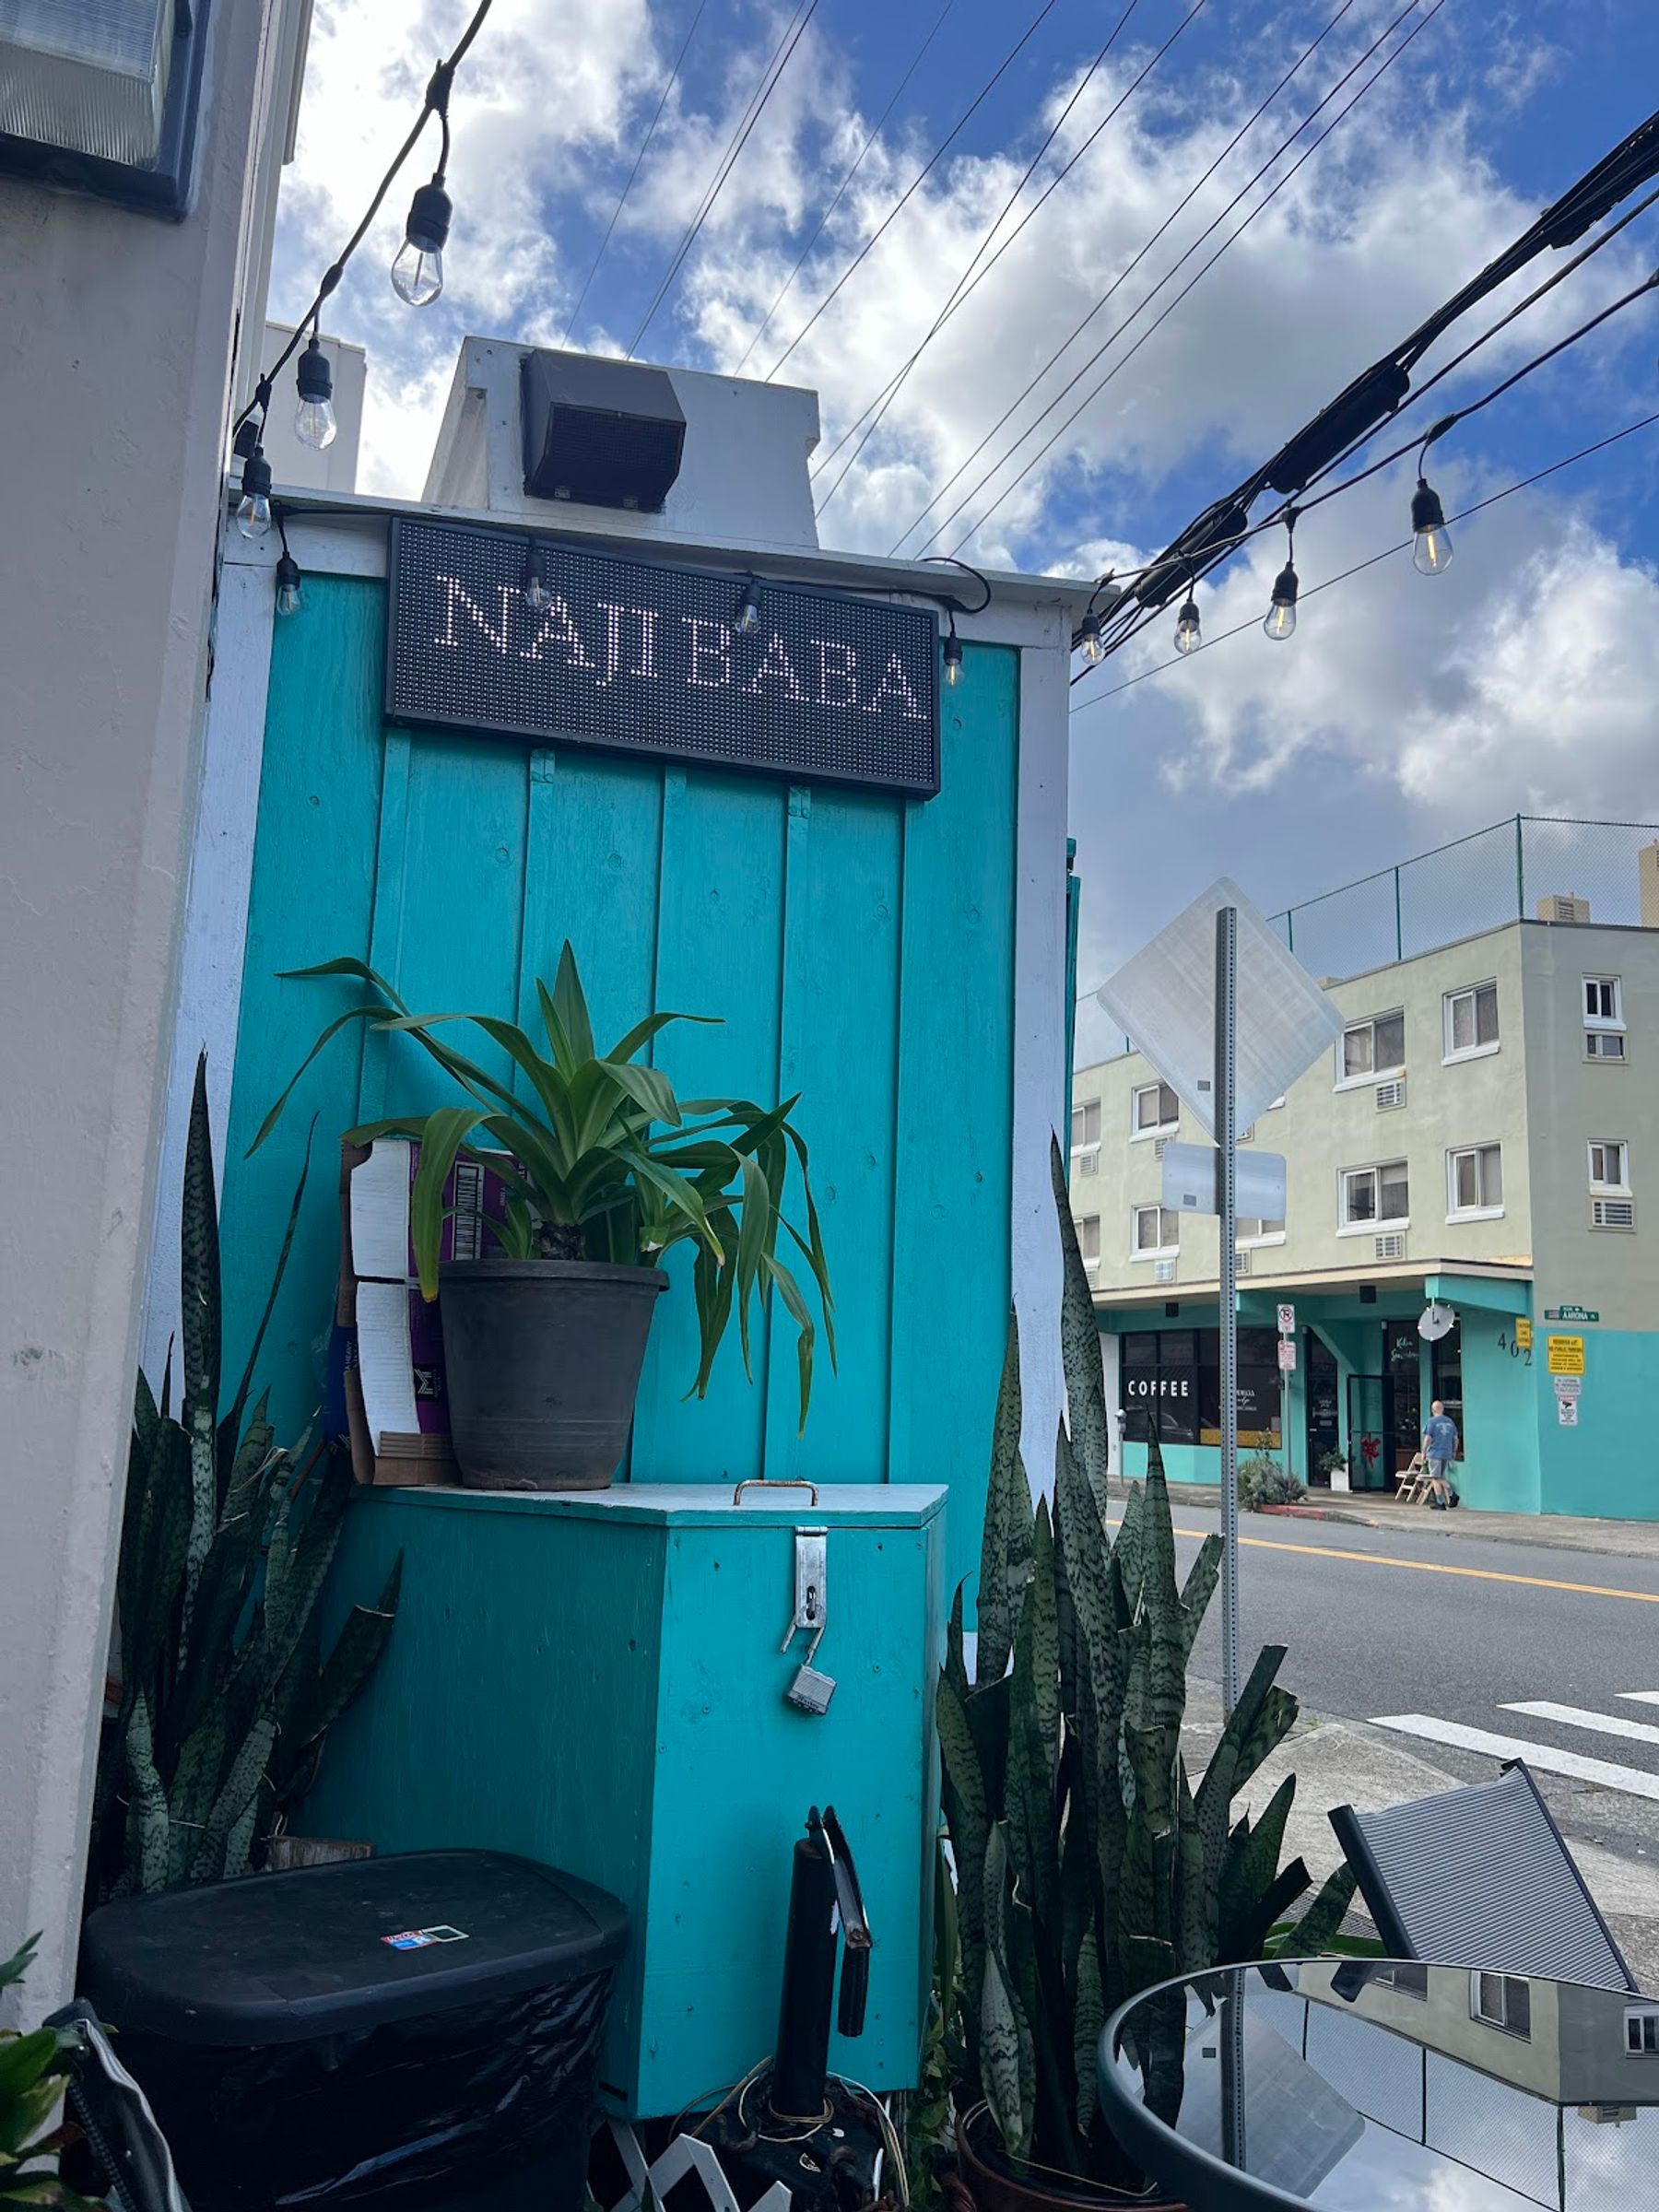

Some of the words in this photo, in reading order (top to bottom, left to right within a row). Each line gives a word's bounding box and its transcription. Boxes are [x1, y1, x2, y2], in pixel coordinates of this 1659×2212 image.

[434, 575, 659, 687] NAJI
[681, 617, 927, 721] BABA
[1498, 1333, 1533, 1366] 402
[1128, 1381, 1189, 1397] COFFEE
